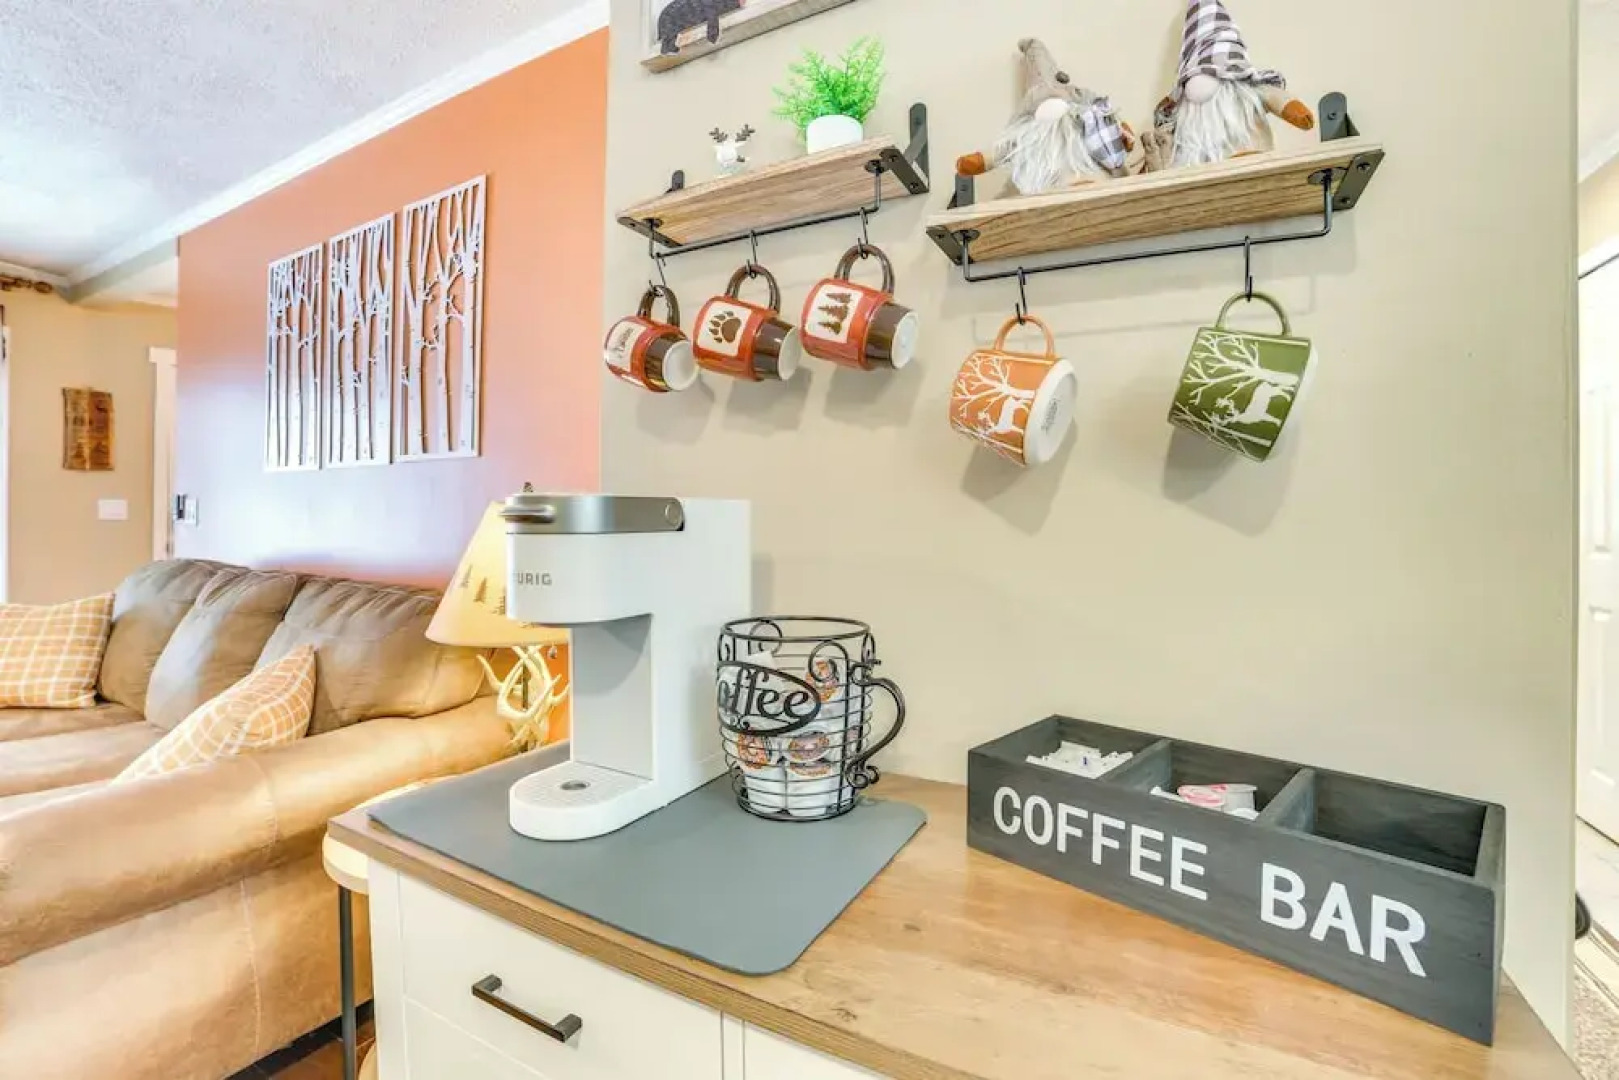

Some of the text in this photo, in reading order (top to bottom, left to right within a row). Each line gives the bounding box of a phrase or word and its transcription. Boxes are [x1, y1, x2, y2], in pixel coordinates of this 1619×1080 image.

[513, 572, 553, 586] URIG
[717, 664, 810, 722] offee
[993, 786, 1427, 978] COFFEE BAR
